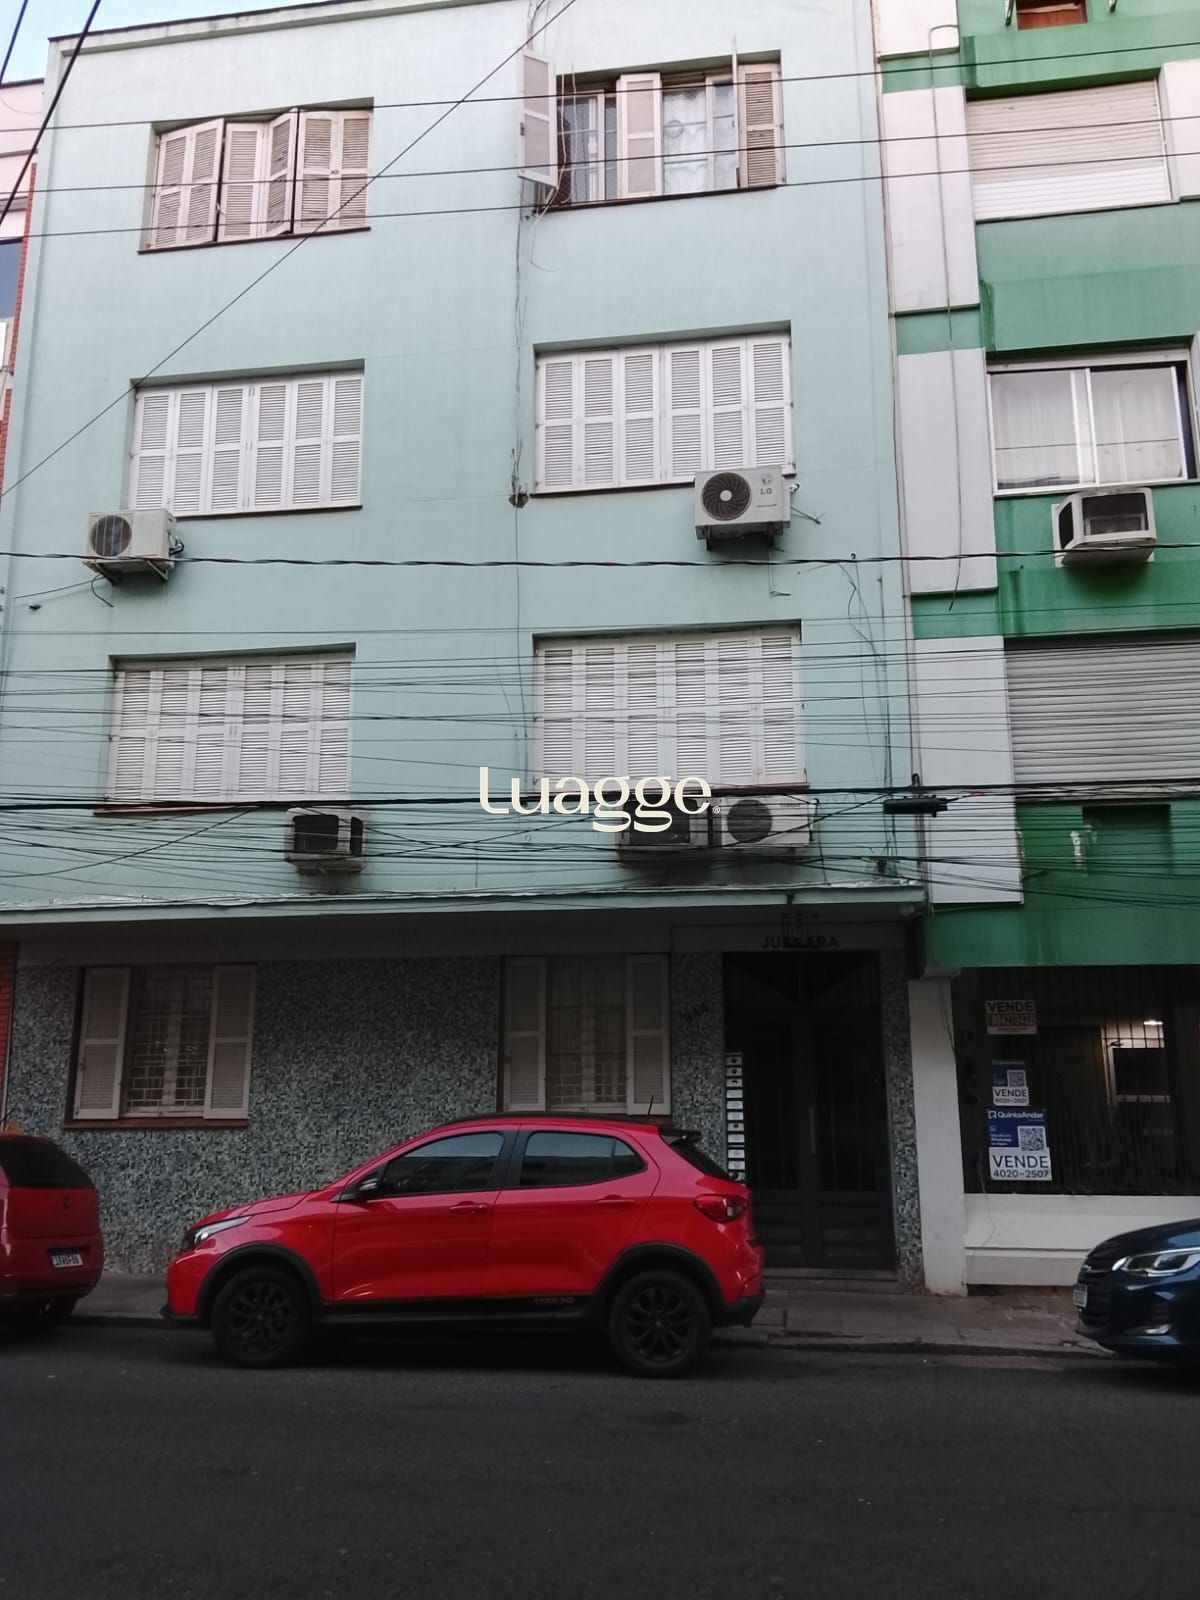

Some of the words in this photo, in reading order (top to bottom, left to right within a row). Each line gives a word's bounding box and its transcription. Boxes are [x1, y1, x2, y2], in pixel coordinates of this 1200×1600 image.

[760, 487, 773, 495] LG
[986, 1001, 1033, 1012] VENDE
[994, 1088, 1028, 1097] VENDE
[997, 1110, 1044, 1119] QuintoAndar
[992, 1155, 1049, 1169] VENDE
[993, 1169, 1049, 1179] 4020-2507
